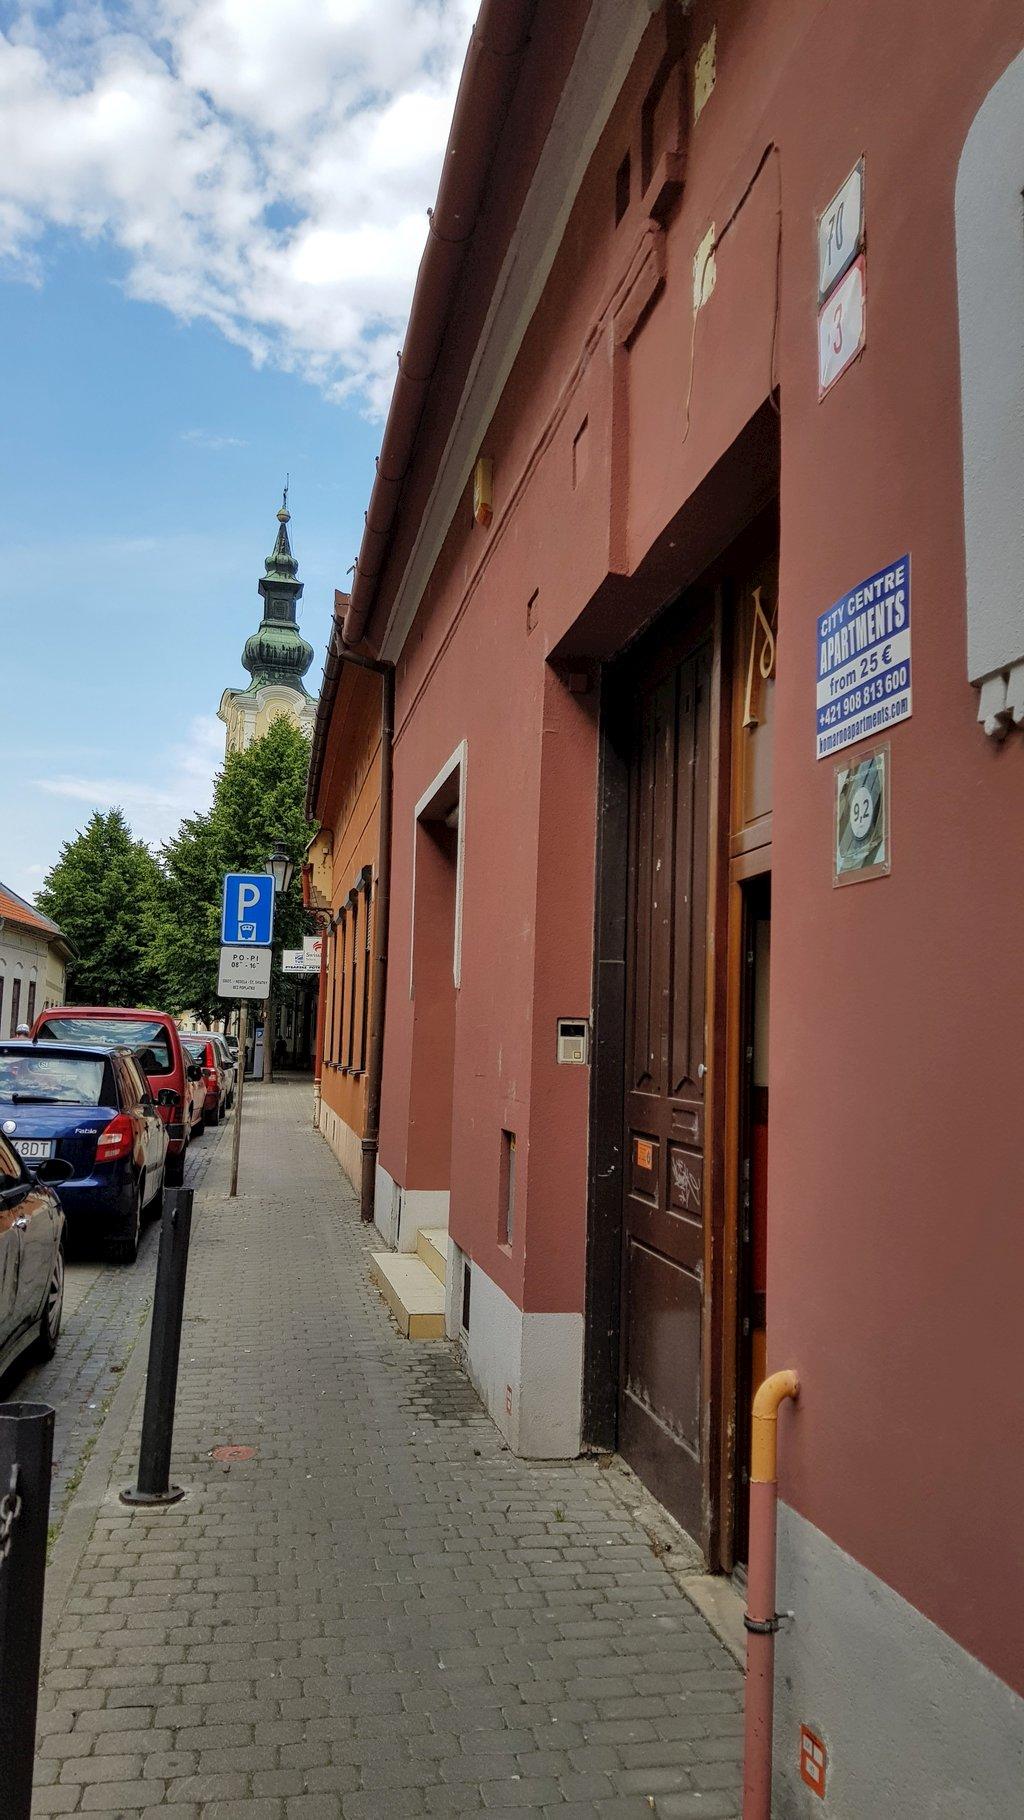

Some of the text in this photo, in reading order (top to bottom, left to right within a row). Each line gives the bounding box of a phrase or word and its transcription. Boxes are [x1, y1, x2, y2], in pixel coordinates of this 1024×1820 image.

[827, 202, 844, 266] 70
[833, 302, 843, 354] 3
[820, 565, 905, 637] CITY CENTRE
[820, 590, 905, 676] APARTMENTS
[819, 666, 907, 727] +421 908 813 600
[829, 644, 893, 696] from 25 €
[819, 695, 909, 754] komarnoapartments.com
[853, 798, 870, 823] 9,2
[238, 883, 261, 921] P
